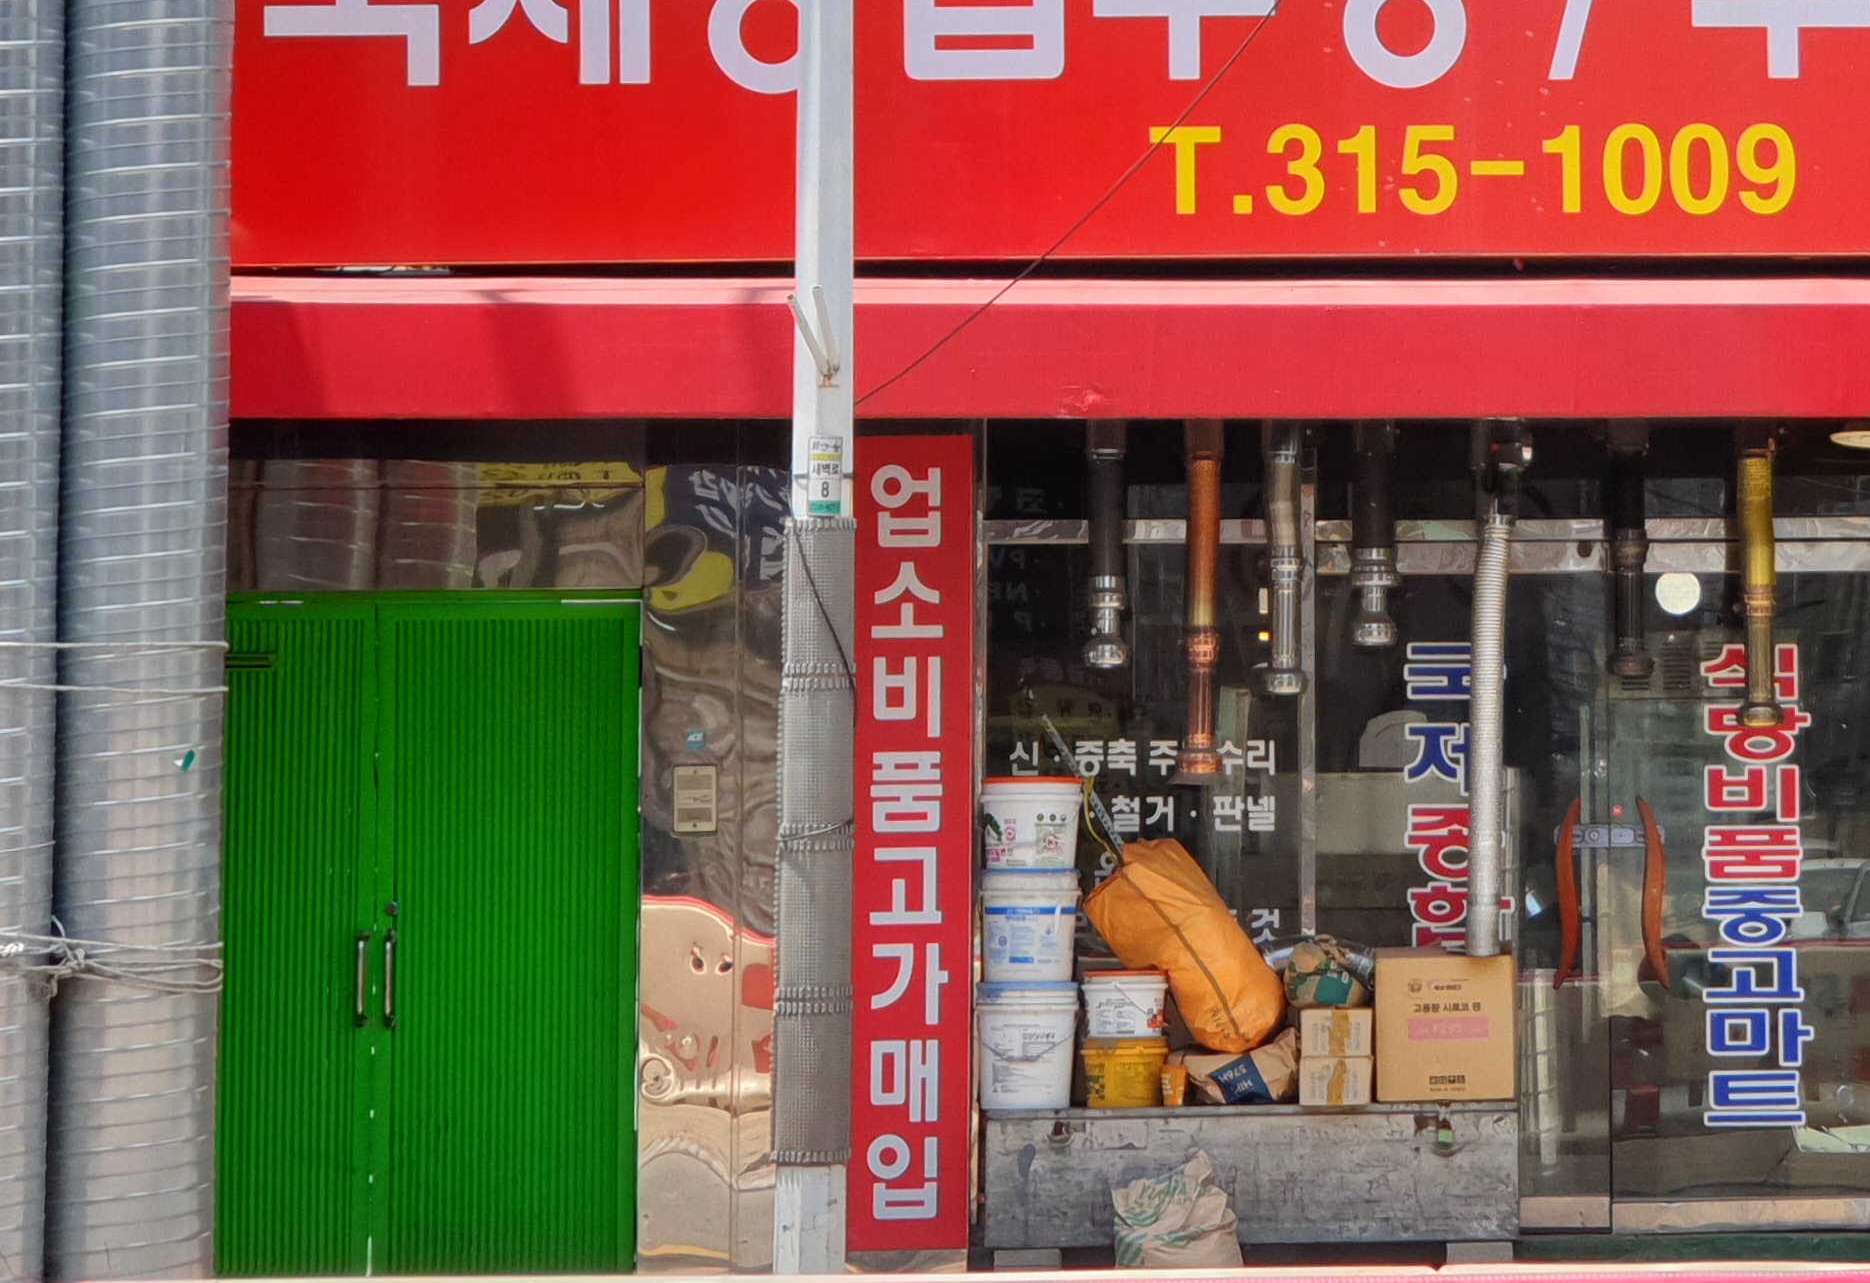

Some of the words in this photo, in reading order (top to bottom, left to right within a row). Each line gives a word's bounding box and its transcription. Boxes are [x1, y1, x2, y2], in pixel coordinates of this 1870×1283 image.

[1150, 123, 1797, 216] T.315-1009
[812, 463, 840, 475] 새벽로
[820, 480, 830, 498] 8
[866, 464, 948, 1221] 업소비품고가매입
[1111, 795, 1175, 833] 철거
[1212, 795, 1276, 832] 판넬
[1700, 643, 1814, 1127] 식당비품중고마트
